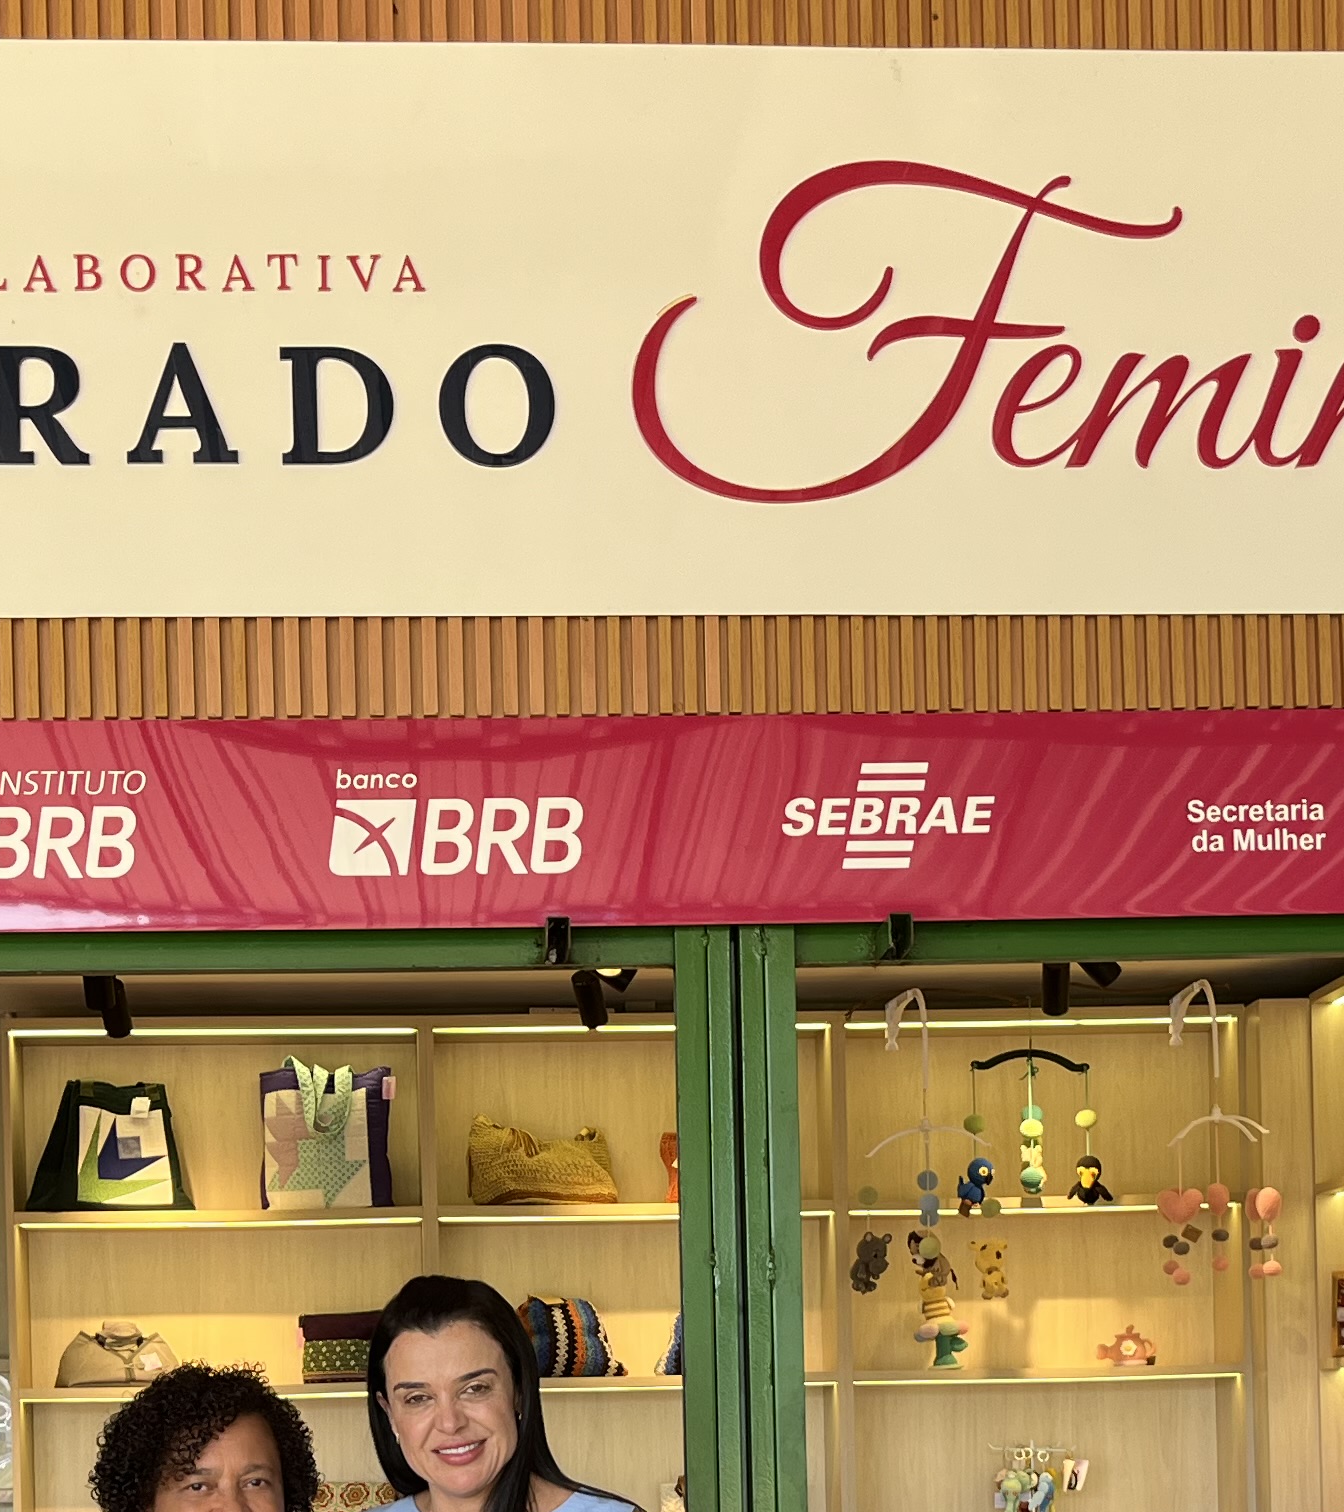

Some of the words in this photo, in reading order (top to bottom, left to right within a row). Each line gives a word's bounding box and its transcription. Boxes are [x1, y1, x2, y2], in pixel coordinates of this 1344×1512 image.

[335, 768, 418, 790] banco
[781, 795, 996, 837] SEBRAE
[1186, 798, 1325, 824] Secretaria
[420, 796, 584, 876] BRB
[1191, 830, 1225, 852] da
[1232, 828, 1327, 852] Mulher
